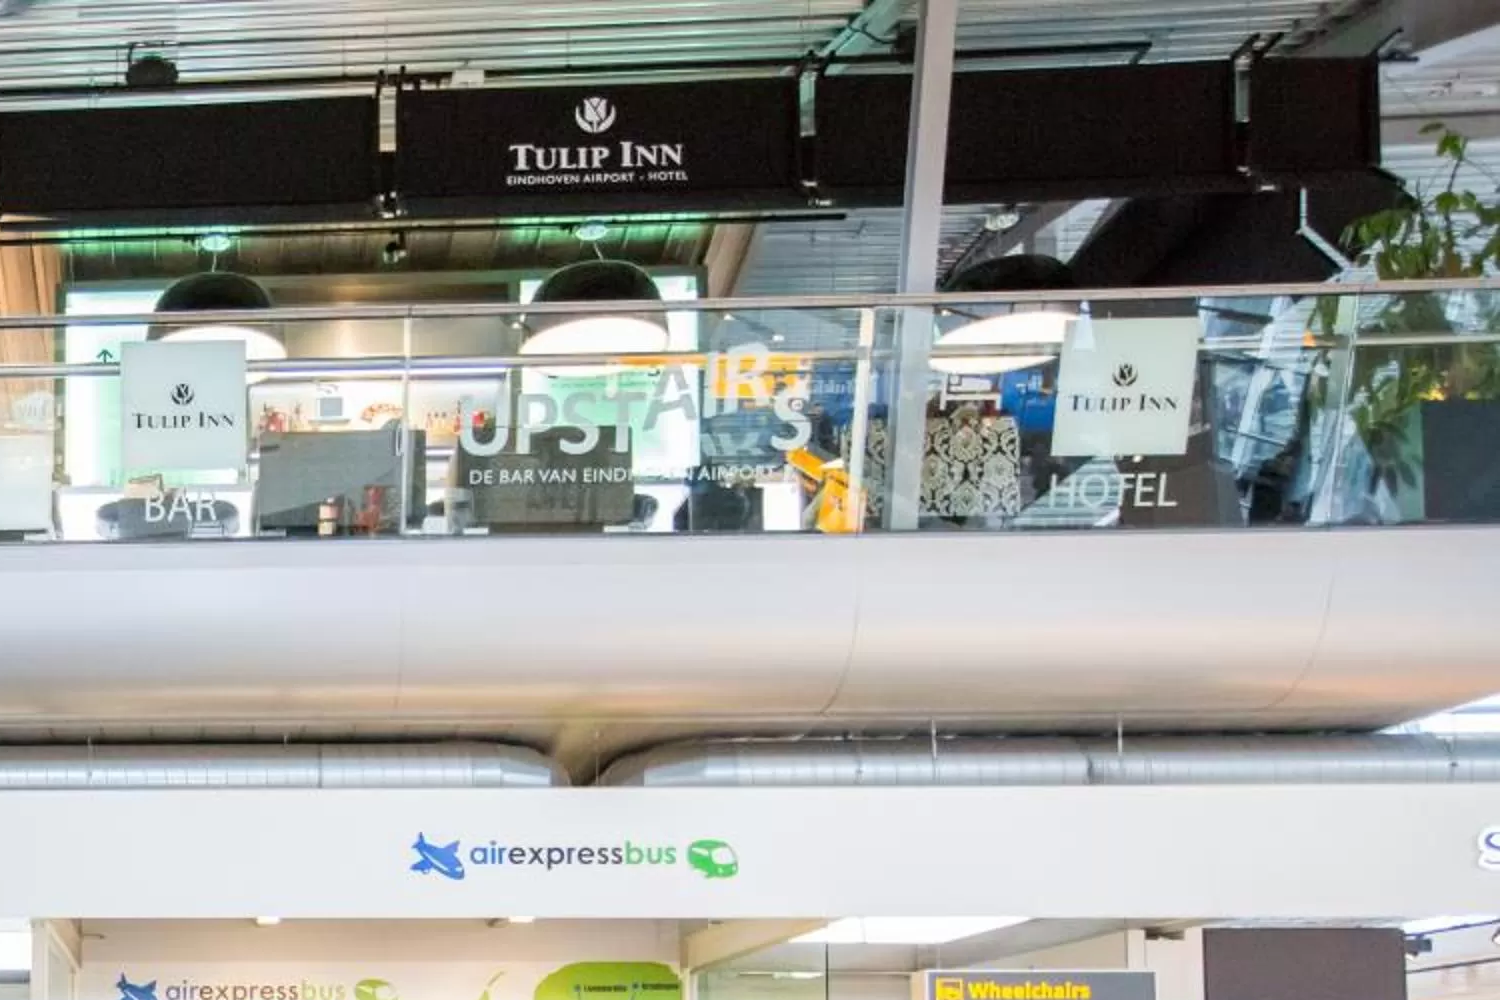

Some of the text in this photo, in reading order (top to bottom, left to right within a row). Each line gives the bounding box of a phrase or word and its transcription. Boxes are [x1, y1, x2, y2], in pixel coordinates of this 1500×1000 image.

[509, 141, 684, 171] TULIP INN
[507, 174, 580, 186] EINDHOVEN
[583, 172, 634, 184] AIRPORT
[647, 171, 688, 181] HOTEL
[458, 341, 812, 457] UPSTAIRS
[1070, 394, 1179, 412] TULIP INN
[131, 411, 235, 429] TULIP INN
[469, 469, 493, 486] DE
[499, 468, 535, 485] BAR
[538, 467, 576, 485] VAN
[1051, 472, 1179, 509] HOTEL
[144, 488, 218, 524] BAR
[469, 840, 677, 871] airexpressbus
[967, 980, 1093, 1000] Wheelchairs
